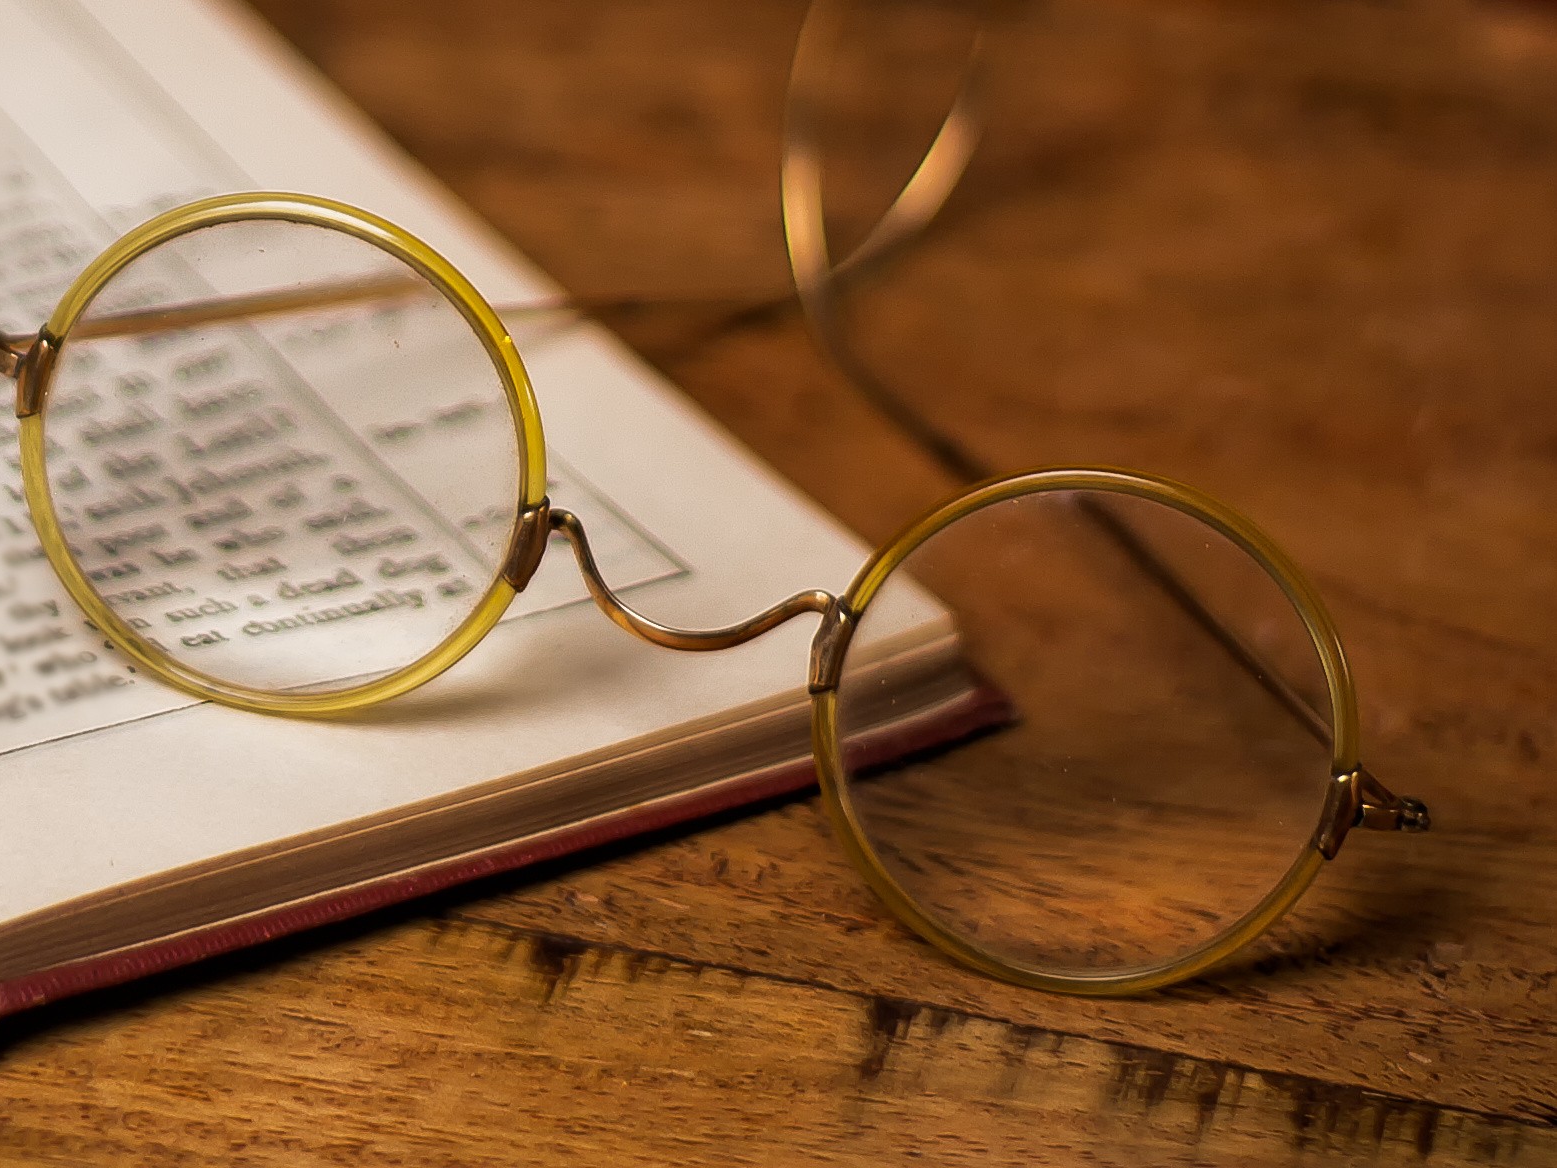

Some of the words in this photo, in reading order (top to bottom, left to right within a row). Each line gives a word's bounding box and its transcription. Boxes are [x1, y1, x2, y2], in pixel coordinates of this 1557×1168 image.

[163, 597, 239, 625] such
[276, 568, 364, 601] dead
[240, 588, 427, 638] continually
